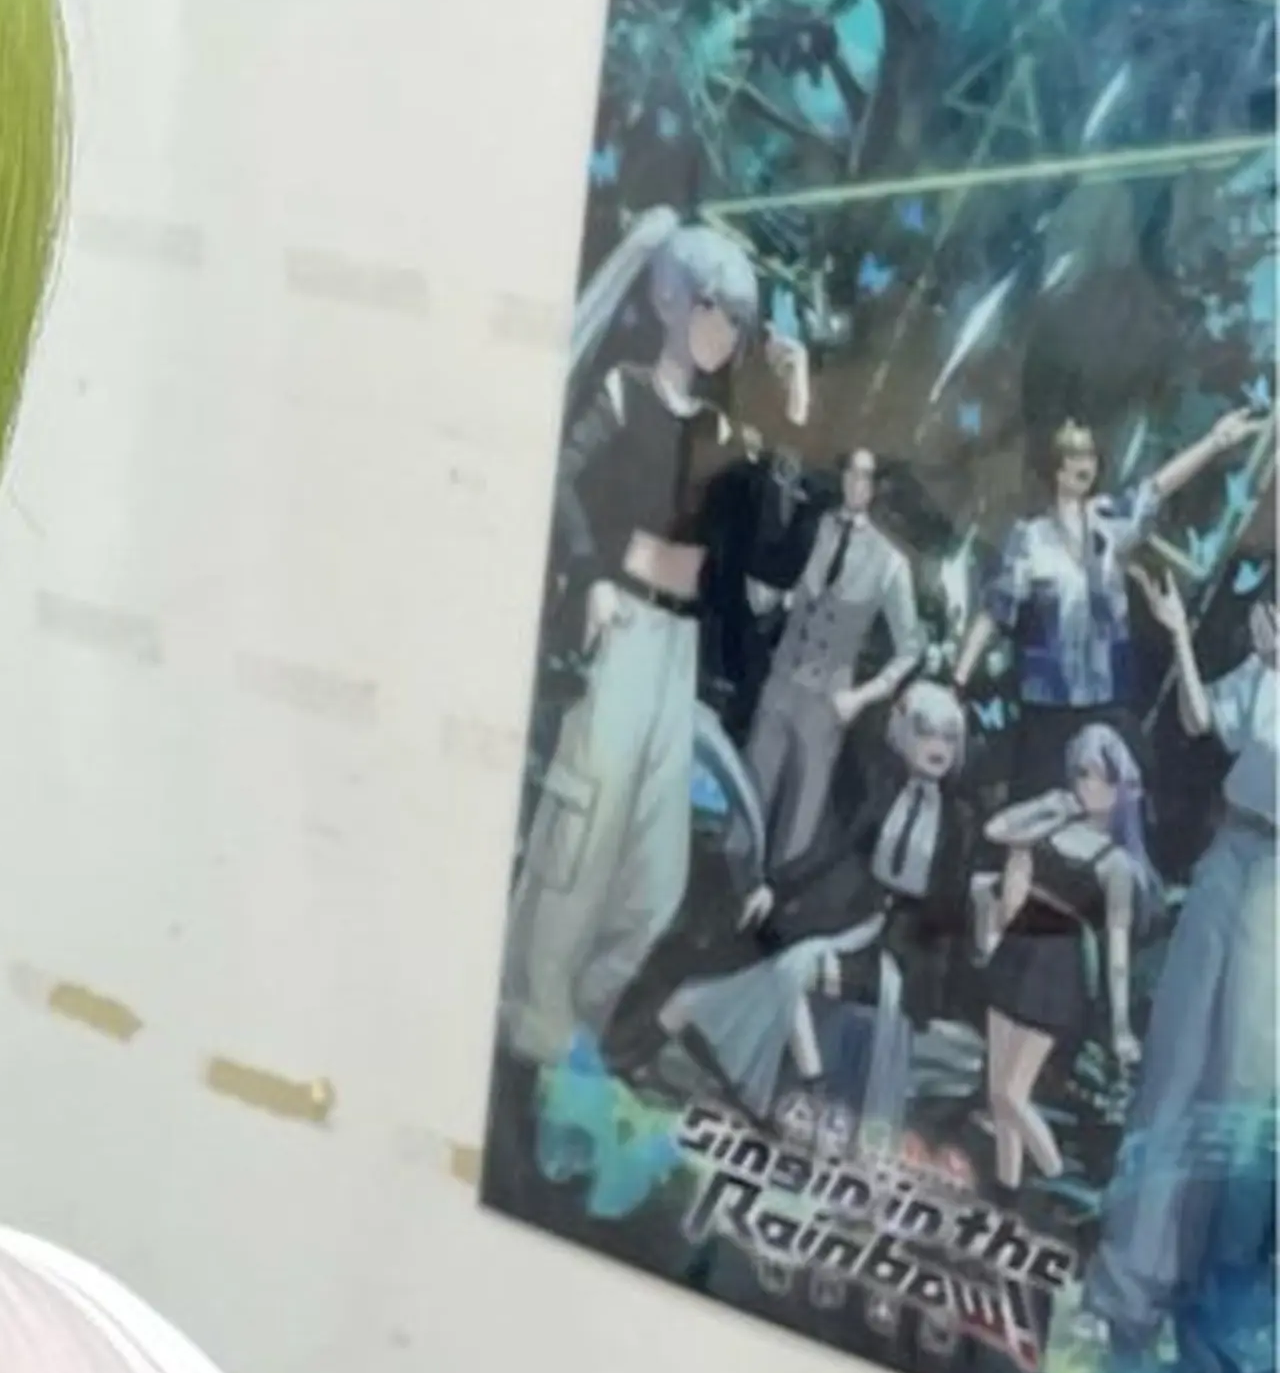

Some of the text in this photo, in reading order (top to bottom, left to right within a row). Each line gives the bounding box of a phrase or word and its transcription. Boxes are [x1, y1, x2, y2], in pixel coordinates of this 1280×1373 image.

[686, 1170, 1039, 1368] Rainbow!
[884, 1180, 944, 1237] in
[954, 1206, 1073, 1286] the
